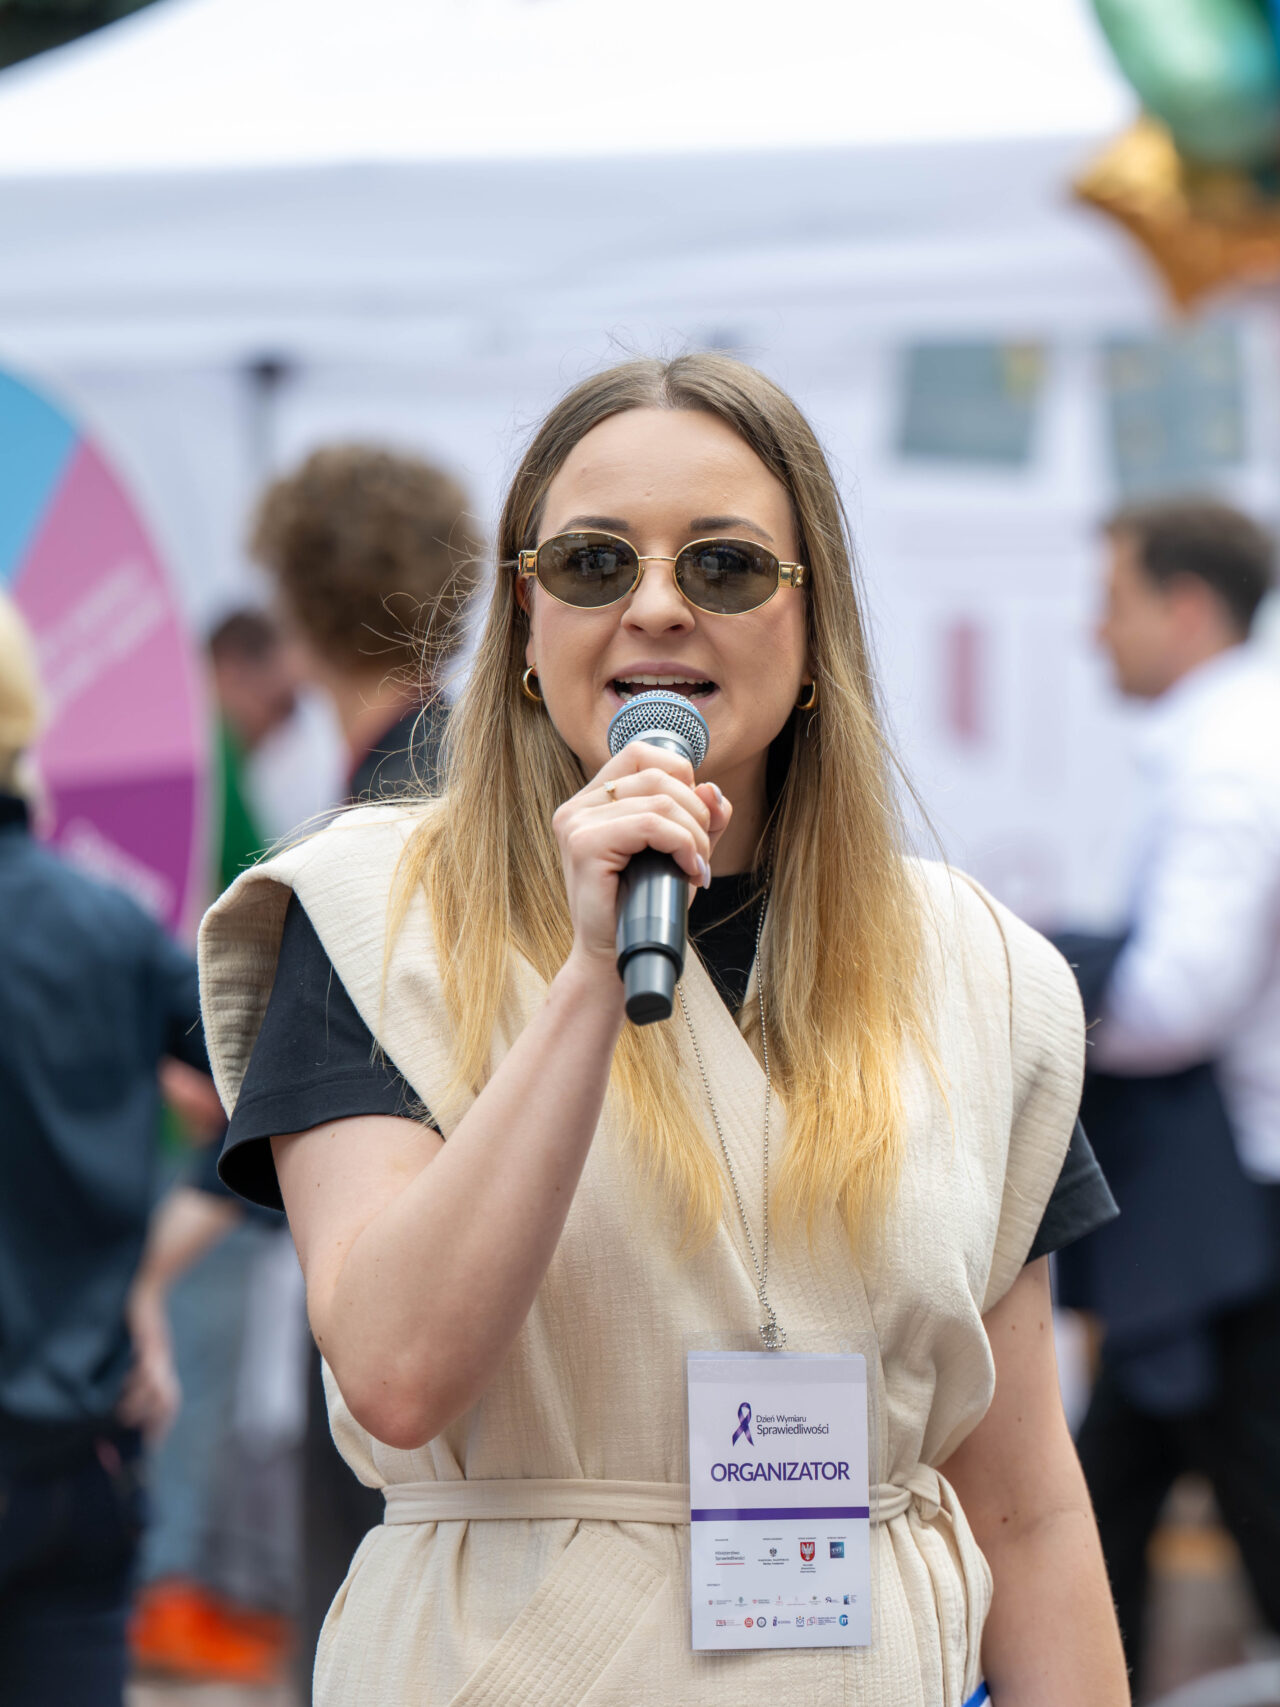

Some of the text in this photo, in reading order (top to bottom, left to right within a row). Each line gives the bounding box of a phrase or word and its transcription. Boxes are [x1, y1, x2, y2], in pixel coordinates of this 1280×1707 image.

[756, 1415, 807, 1424] Dzień Wymiaru
[757, 1424, 829, 1437] Sprawiedliwości
[710, 1462, 851, 1482] ORGANIZATOR
